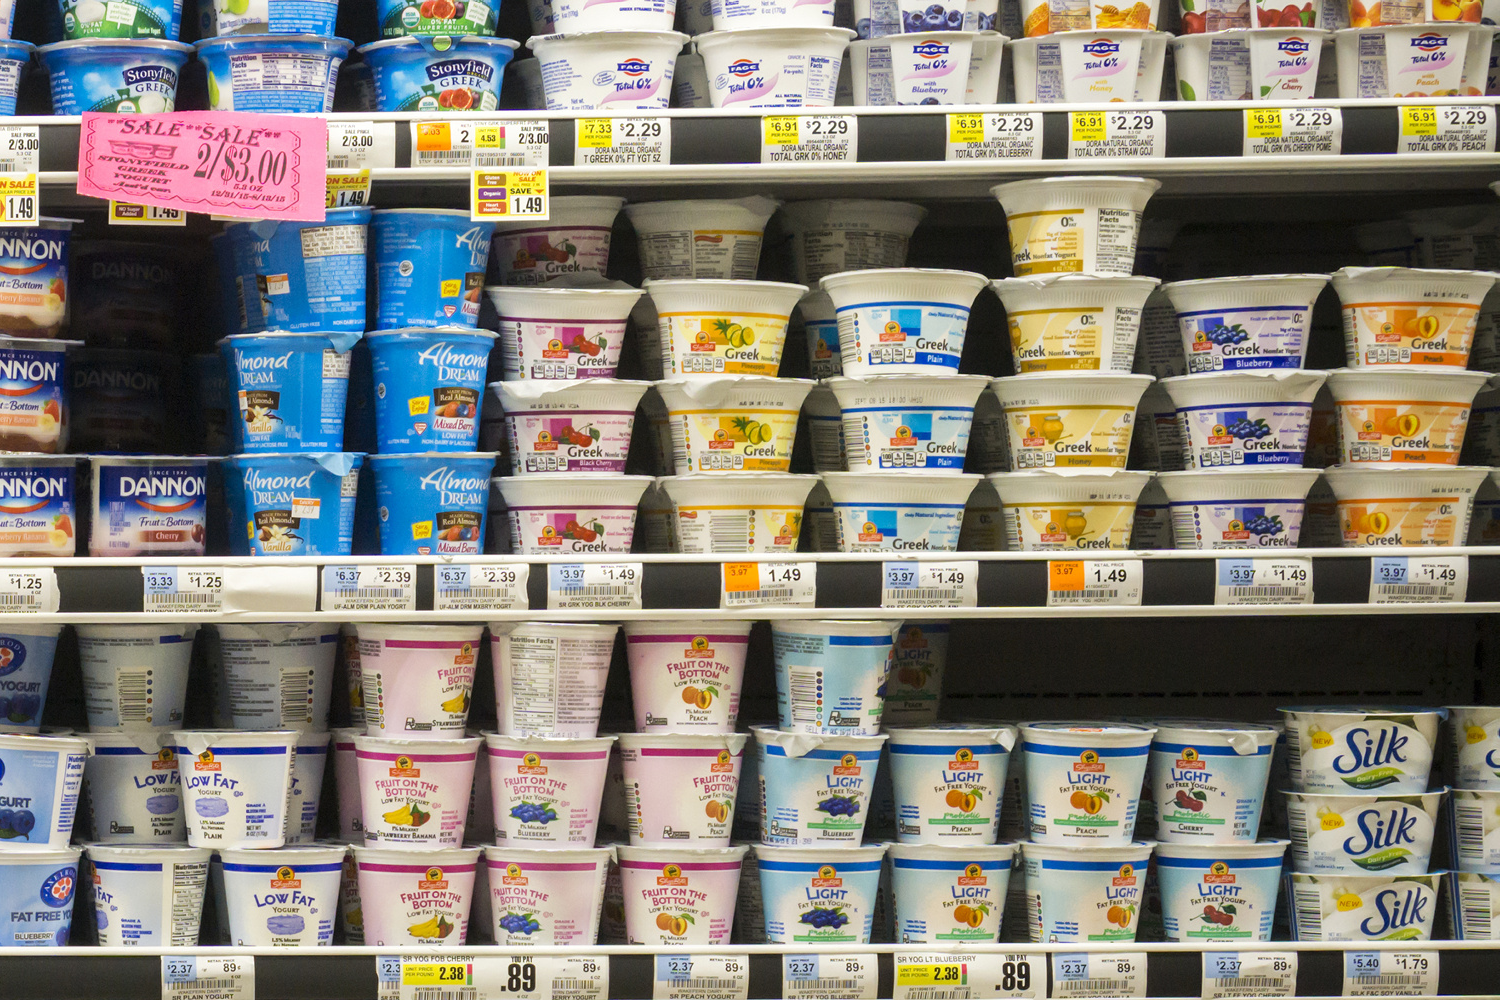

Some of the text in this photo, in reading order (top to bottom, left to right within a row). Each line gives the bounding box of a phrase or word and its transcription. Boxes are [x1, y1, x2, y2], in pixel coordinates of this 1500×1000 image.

[1281, 83, 1302, 91] Cherry
[1290, 113, 1332, 127] $2.29
[585, 123, 661, 137] $7.33 $2.29
[98, 156, 189, 170] STONYFIELD
[194, 142, 287, 185] 2/$3.00
[584, 155, 588, 163] T
[590, 155, 613, 163] GREEK
[637, 154, 651, 162] YGT
[9, 198, 32, 218] 1.49
[915, 338, 948, 351] Greek
[1222, 344, 1260, 356] Greek
[419, 343, 488, 367] Almond
[927, 354, 943, 363] Plain
[1236, 359, 1273, 368] Blueberry
[438, 367, 479, 381] DREAM
[567, 446, 602, 458] Greek
[155, 531, 179, 541] Cherry
[379, 571, 411, 582] $2.39
[603, 569, 635, 580] $1.49
[1094, 569, 1126, 582] 1.49
[1333, 726, 1408, 773] Silk
[1361, 888, 1426, 935] Silk
[1394, 957, 1428, 970] $1.79
[440, 967, 463, 980] 2.38
[501, 964, 536, 991] .89
[995, 962, 1030, 990] .89
